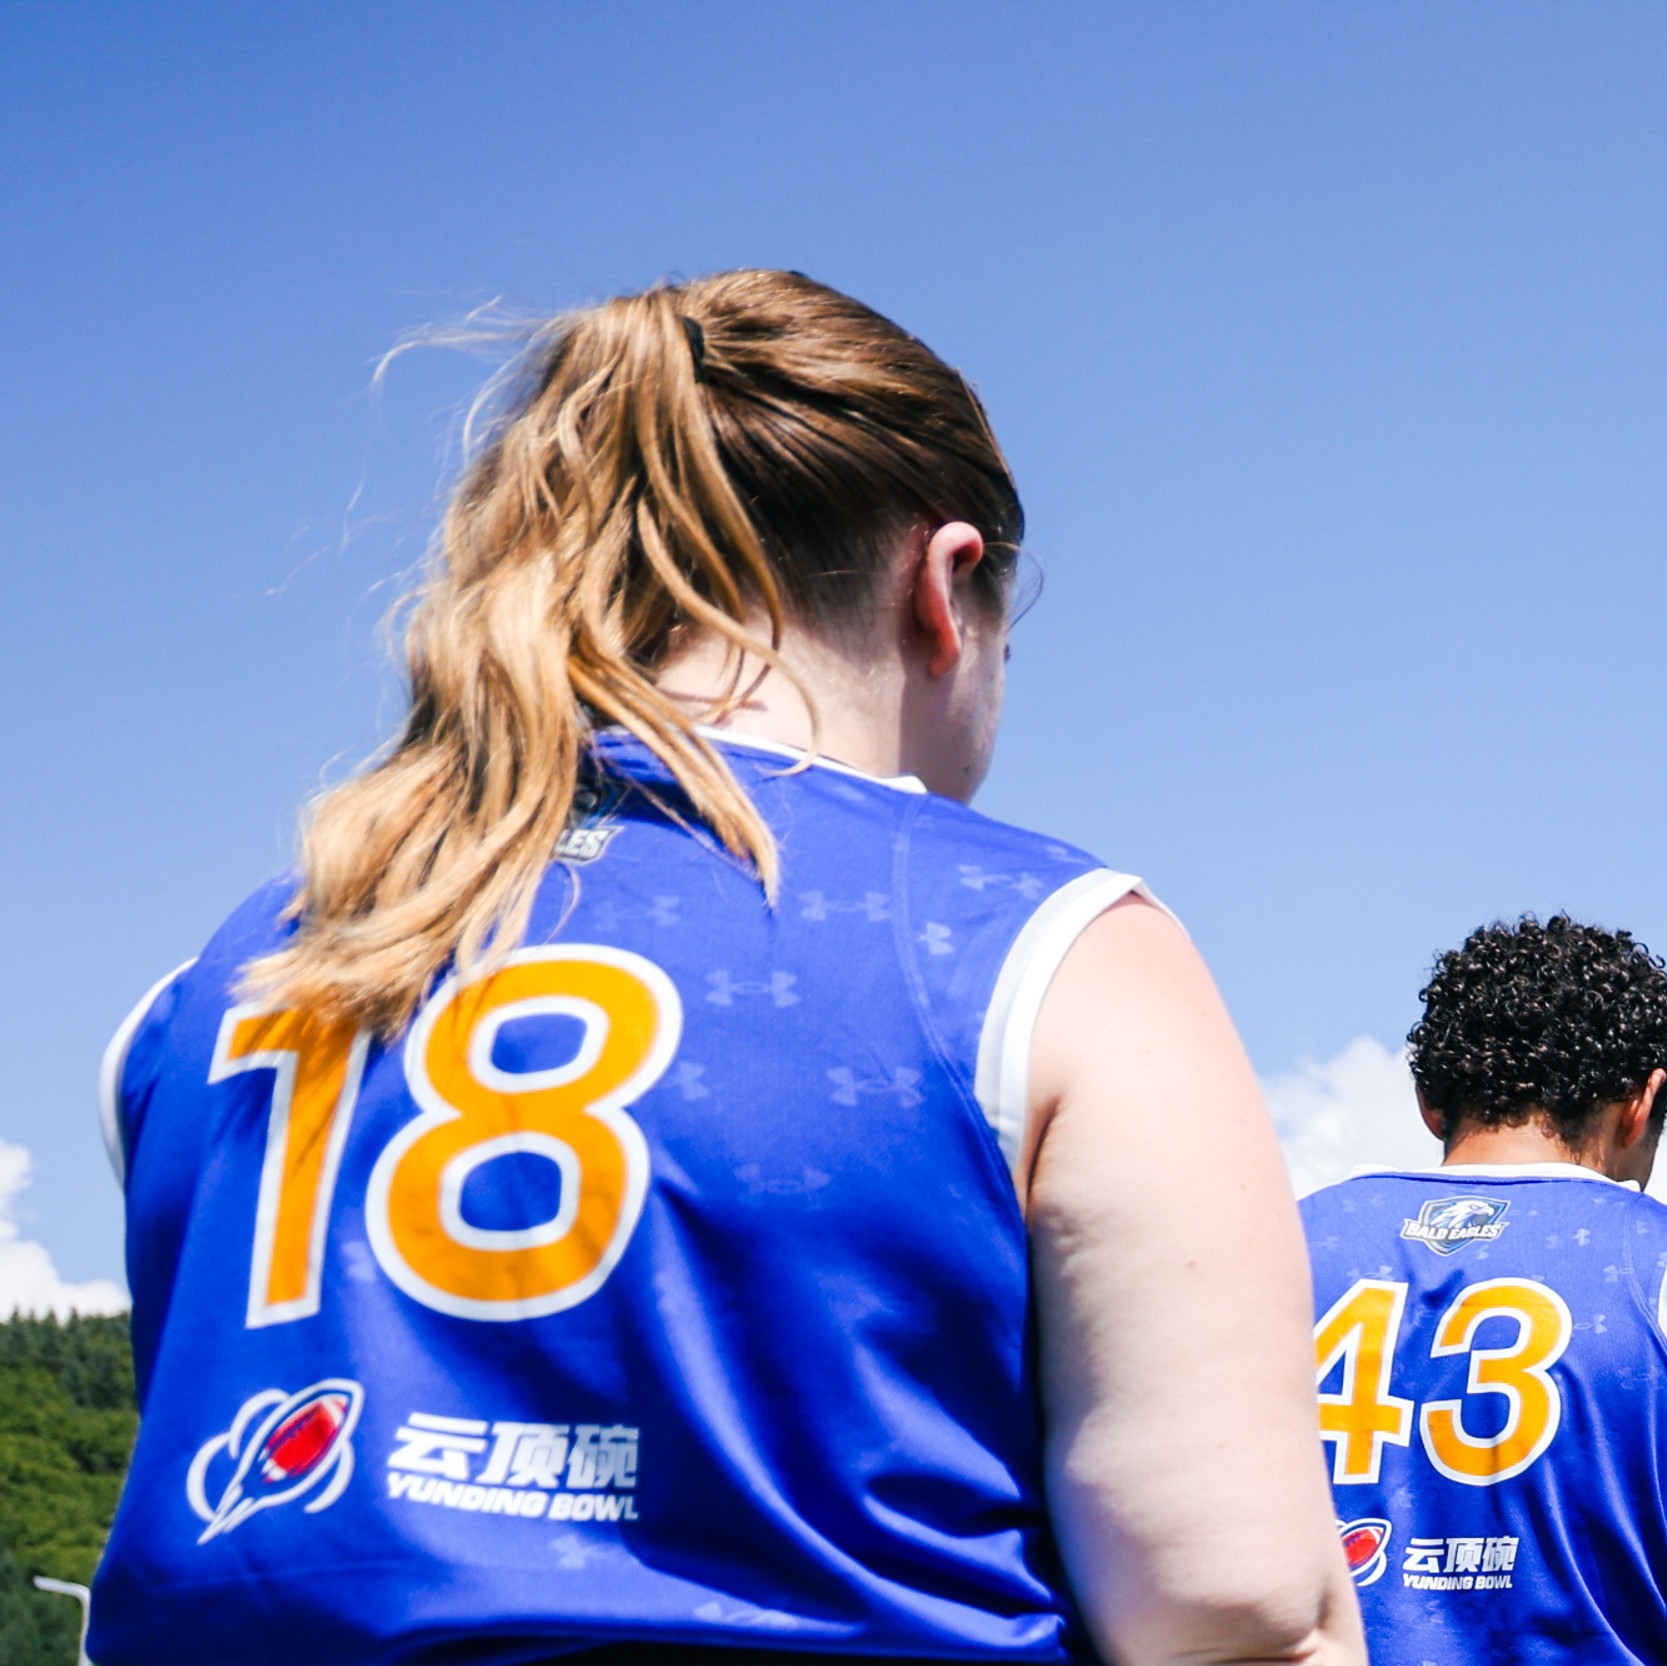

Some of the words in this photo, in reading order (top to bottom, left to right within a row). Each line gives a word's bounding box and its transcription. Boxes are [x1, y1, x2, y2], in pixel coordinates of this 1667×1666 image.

[208, 943, 683, 1329] 18
[1405, 1222, 1449, 1239] BALD
[1448, 1224, 1501, 1240] EAGLES
[1313, 1277, 1573, 1486] 43
[387, 1411, 640, 1489] 云顶碗
[387, 1471, 550, 1519] YUNDING
[548, 1492, 639, 1522] BOWL
[1402, 1535, 1520, 1574] 云顶碗
[1402, 1573, 1473, 1591] YUNDING
[1474, 1575, 1513, 1590] BOWL
